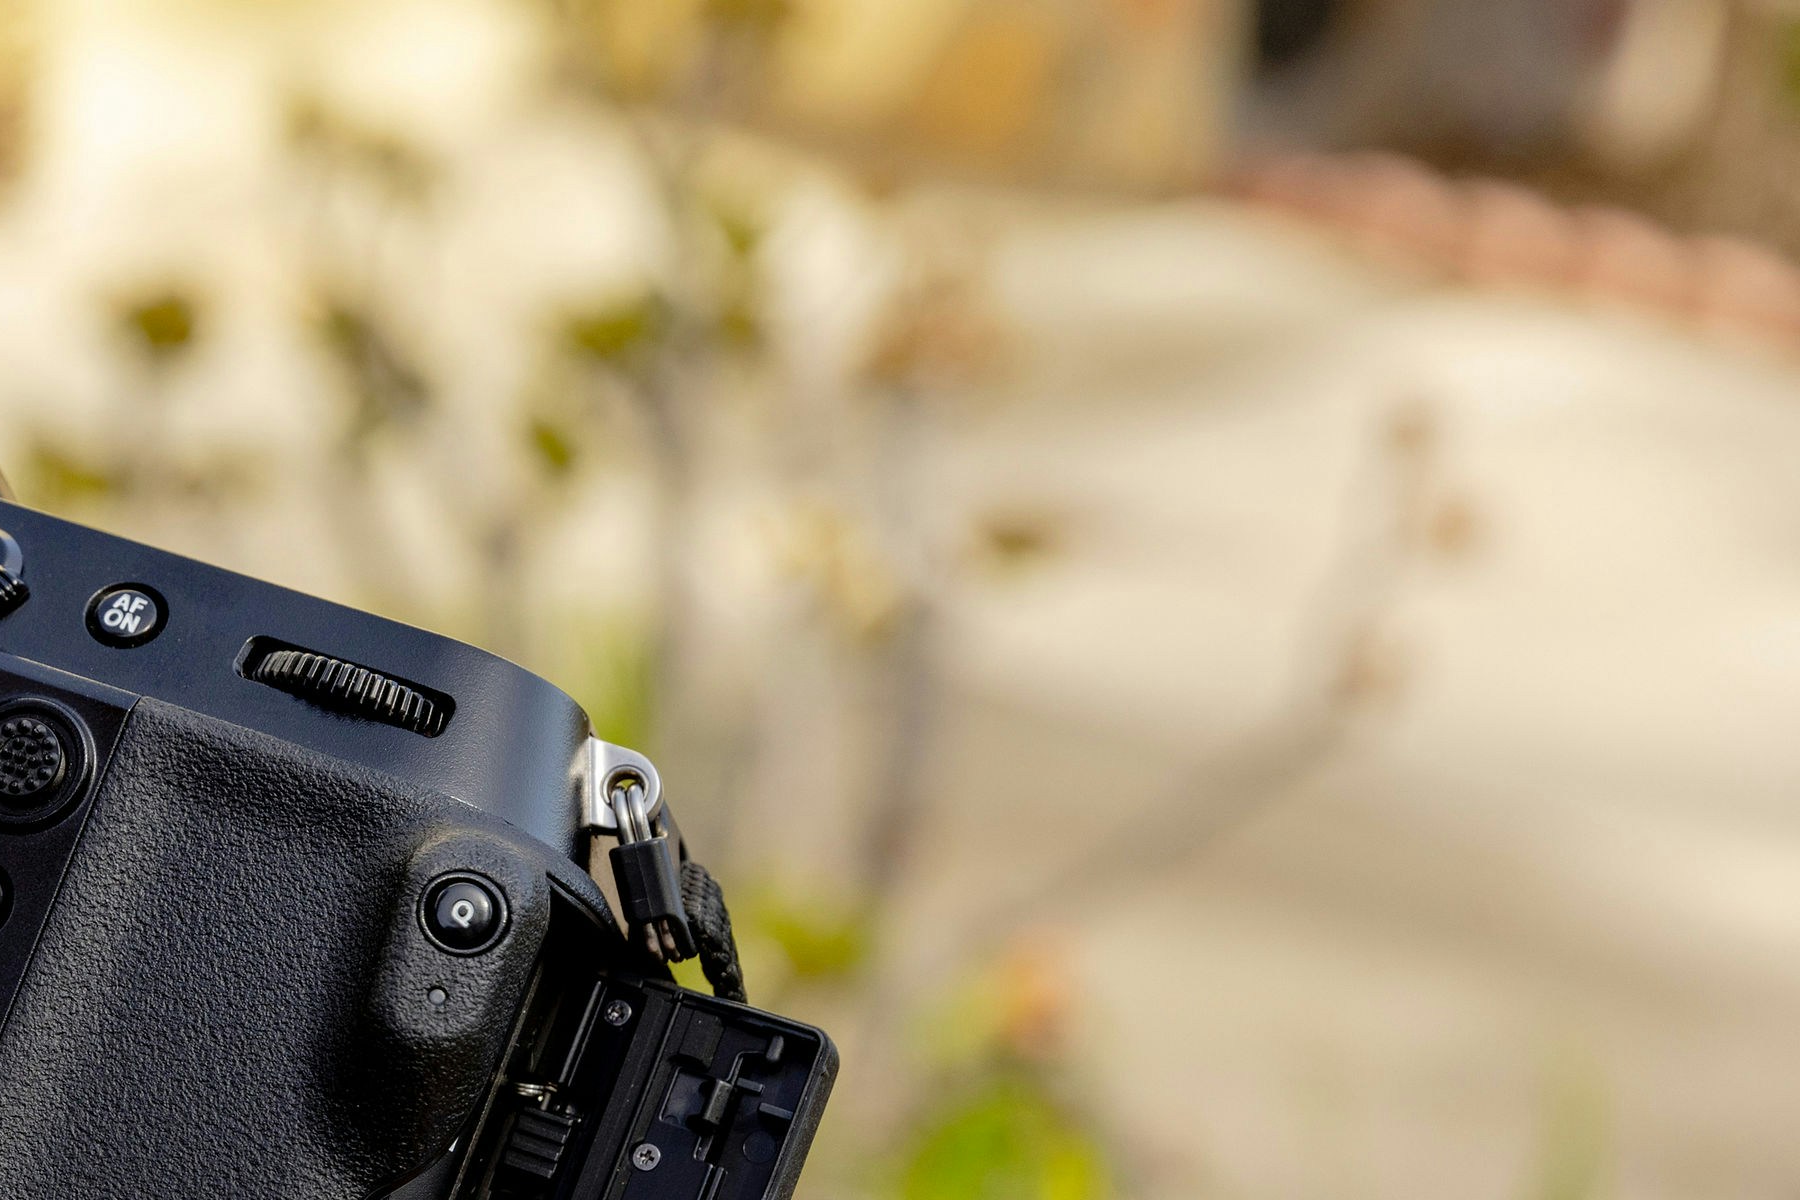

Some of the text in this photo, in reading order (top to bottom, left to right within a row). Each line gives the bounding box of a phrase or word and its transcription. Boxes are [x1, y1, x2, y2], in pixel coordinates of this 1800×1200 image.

[112, 593, 148, 614] AF
[103, 608, 140, 633] ON
[451, 899, 474, 928] Q
